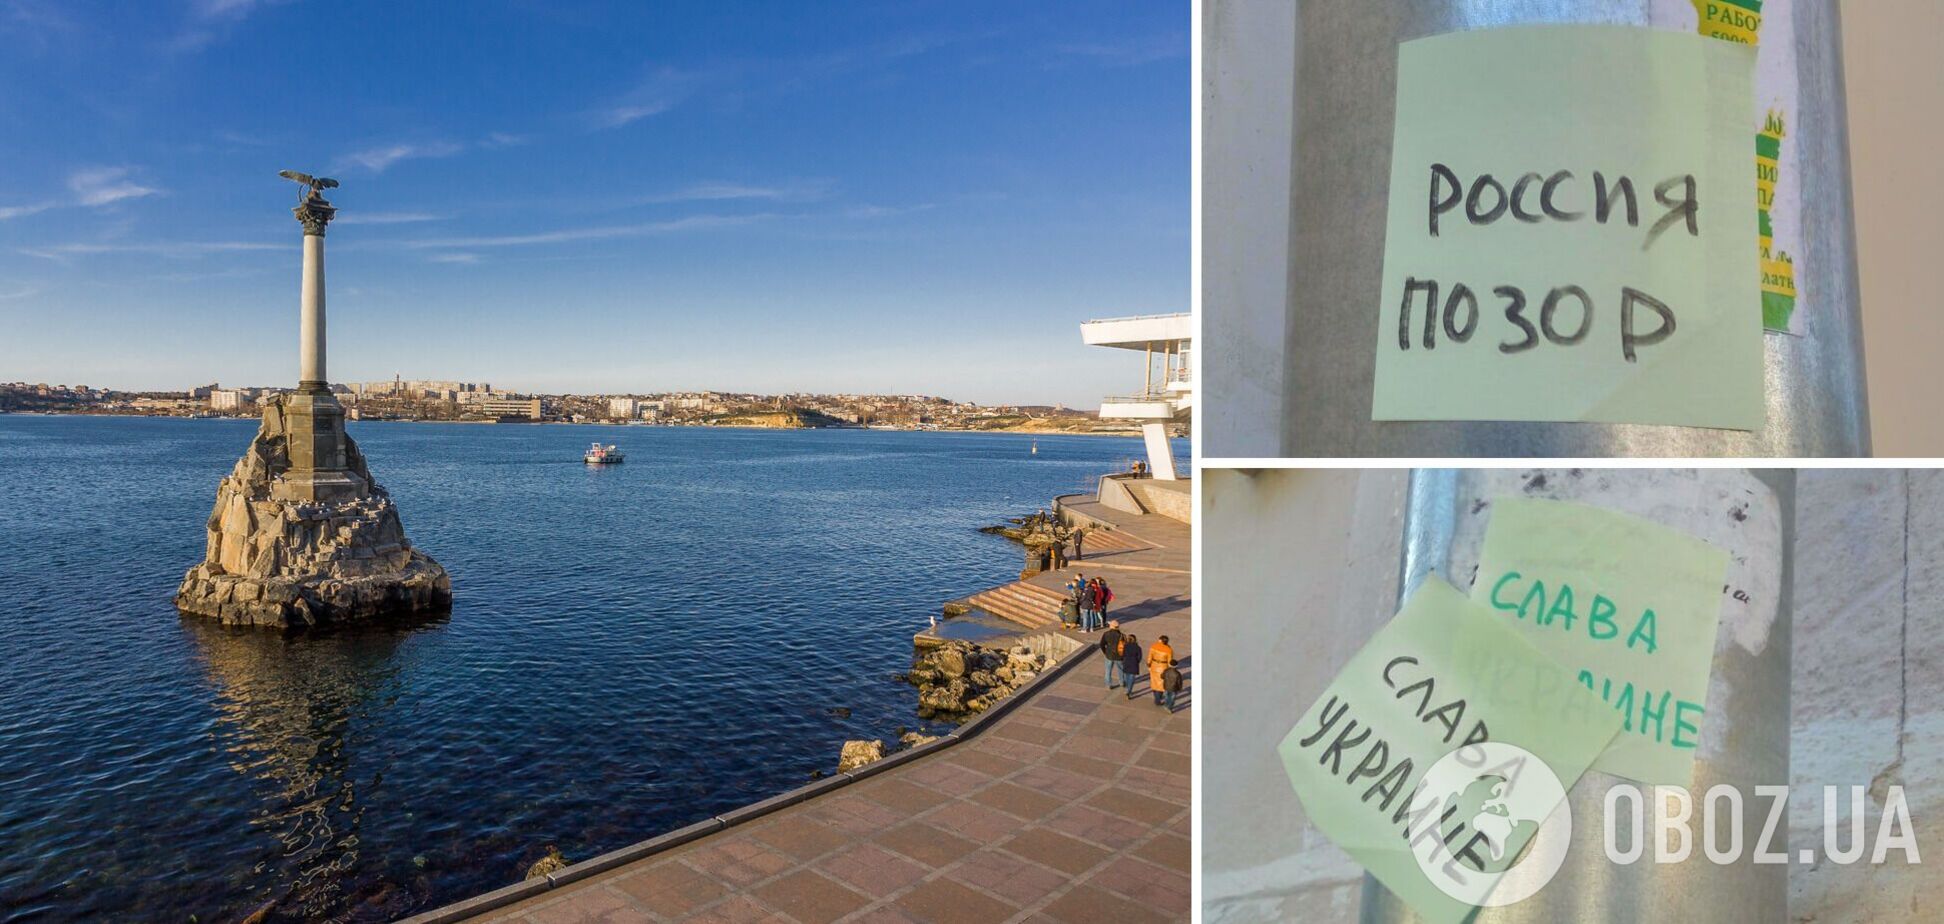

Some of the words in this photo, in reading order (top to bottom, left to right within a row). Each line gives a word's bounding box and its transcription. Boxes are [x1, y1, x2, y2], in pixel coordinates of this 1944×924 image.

[1707, 4, 1761, 32] РАБО
[1399, 276, 1677, 363] ПОЗОР
[1490, 572, 1659, 654] СЛАВА
[1382, 655, 1527, 799] СЛАВА
[1299, 695, 1502, 887] УКРАИНЕ
